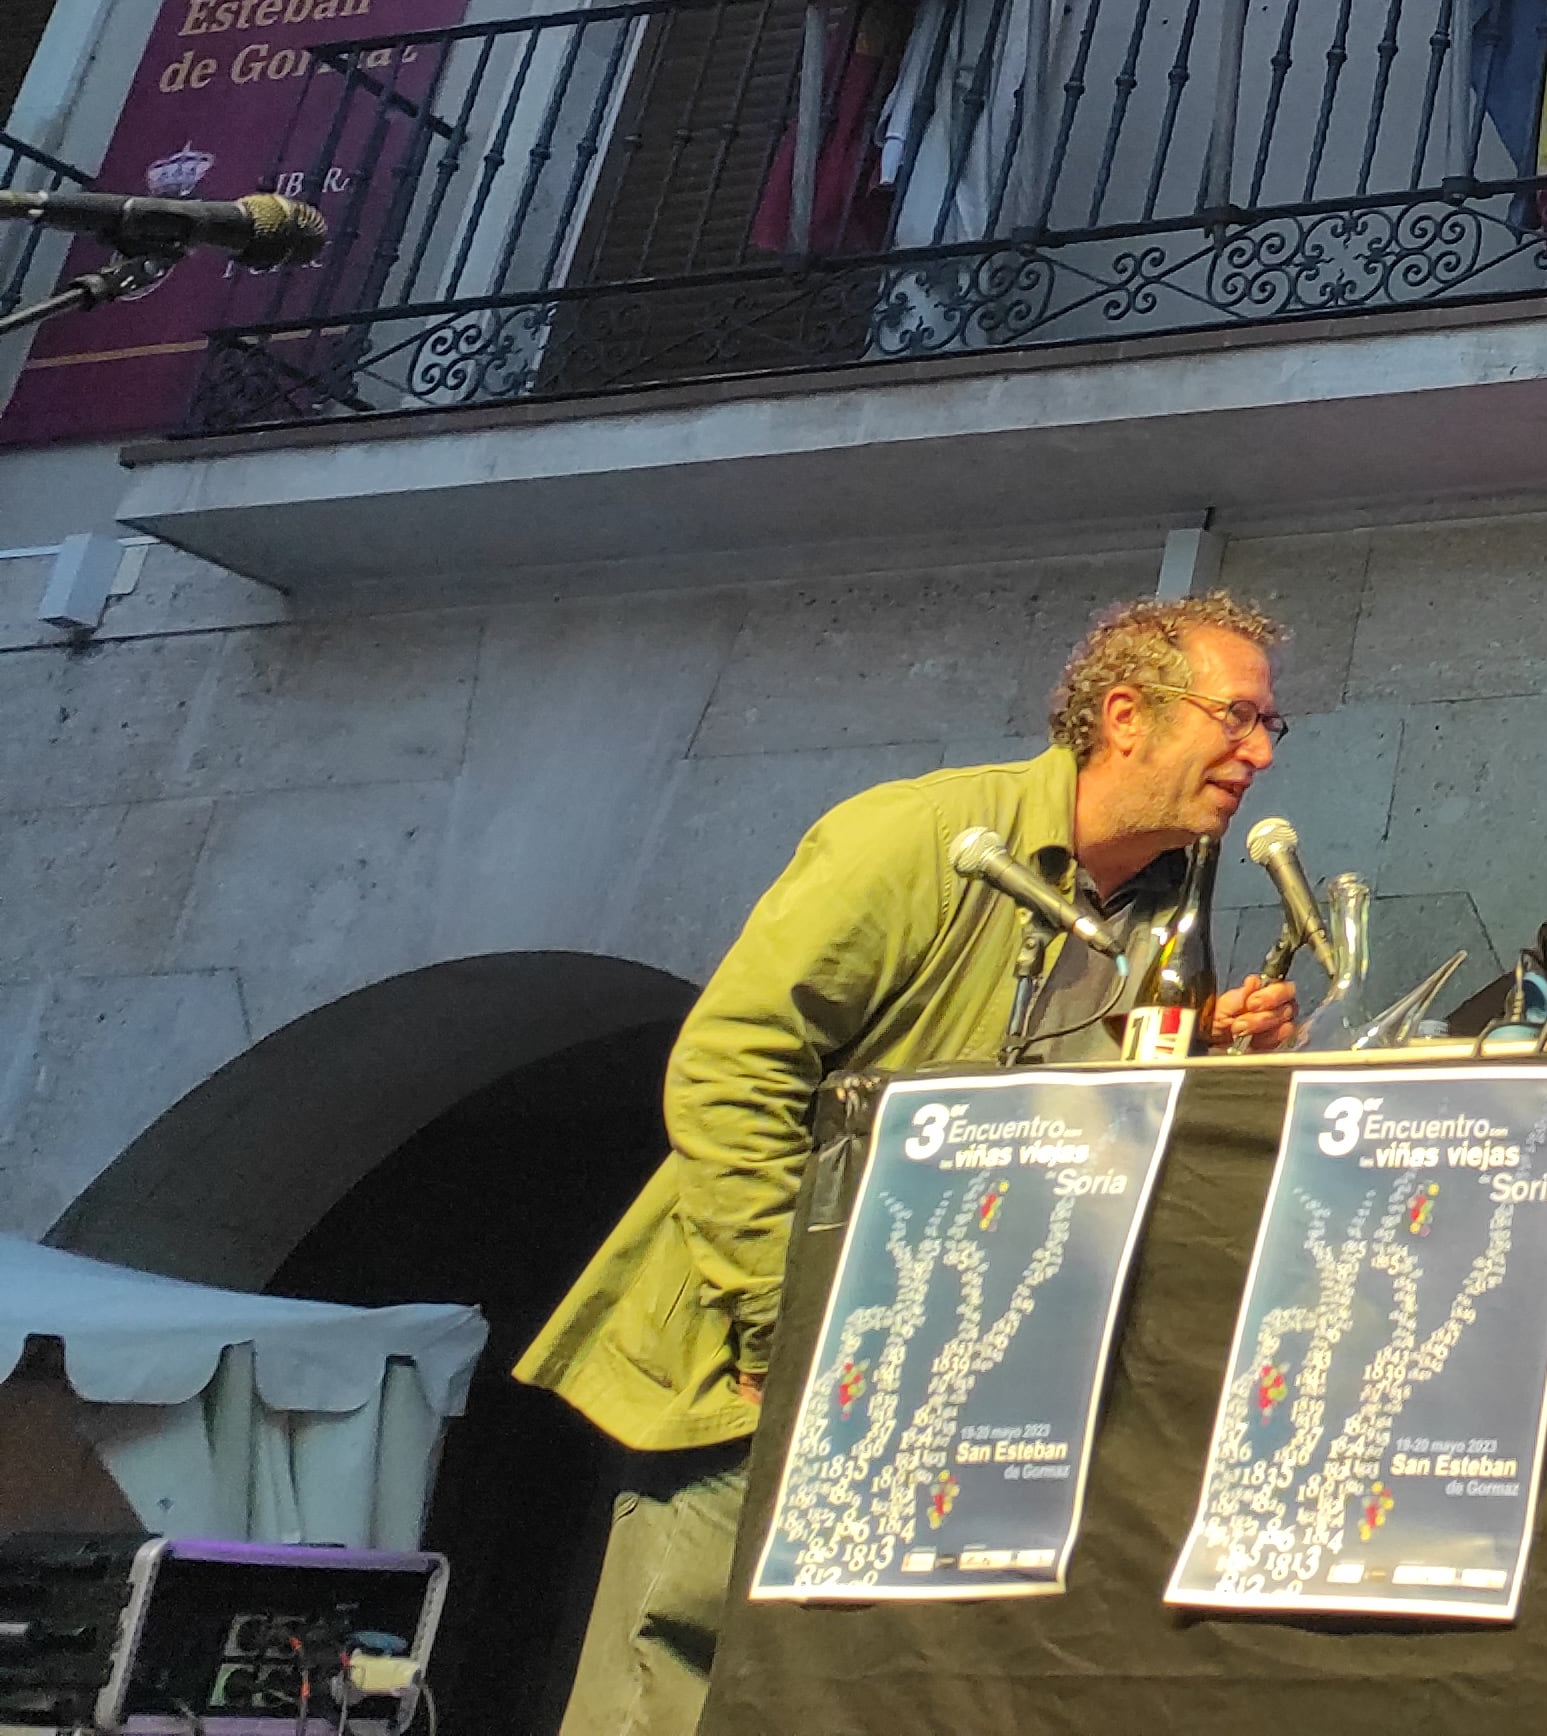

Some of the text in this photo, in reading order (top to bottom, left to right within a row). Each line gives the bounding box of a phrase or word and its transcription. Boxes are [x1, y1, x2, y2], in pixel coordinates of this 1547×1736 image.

[159, 49, 218, 93] de
[947, 1115, 1066, 1144] Encuentro
[1364, 1114, 1490, 1140] Encuentro
[953, 1140, 1089, 1169] viñas viejas
[1376, 1141, 1440, 1168] viñas
[1447, 1140, 1520, 1170] viejas
[1053, 1168, 1127, 1196] Soria
[956, 1440, 1068, 1463] San Esteban
[1391, 1454, 1516, 1477] San Esteban
[841, 1535, 896, 1571] 1813
[1264, 1544, 1322, 1580] 1813
